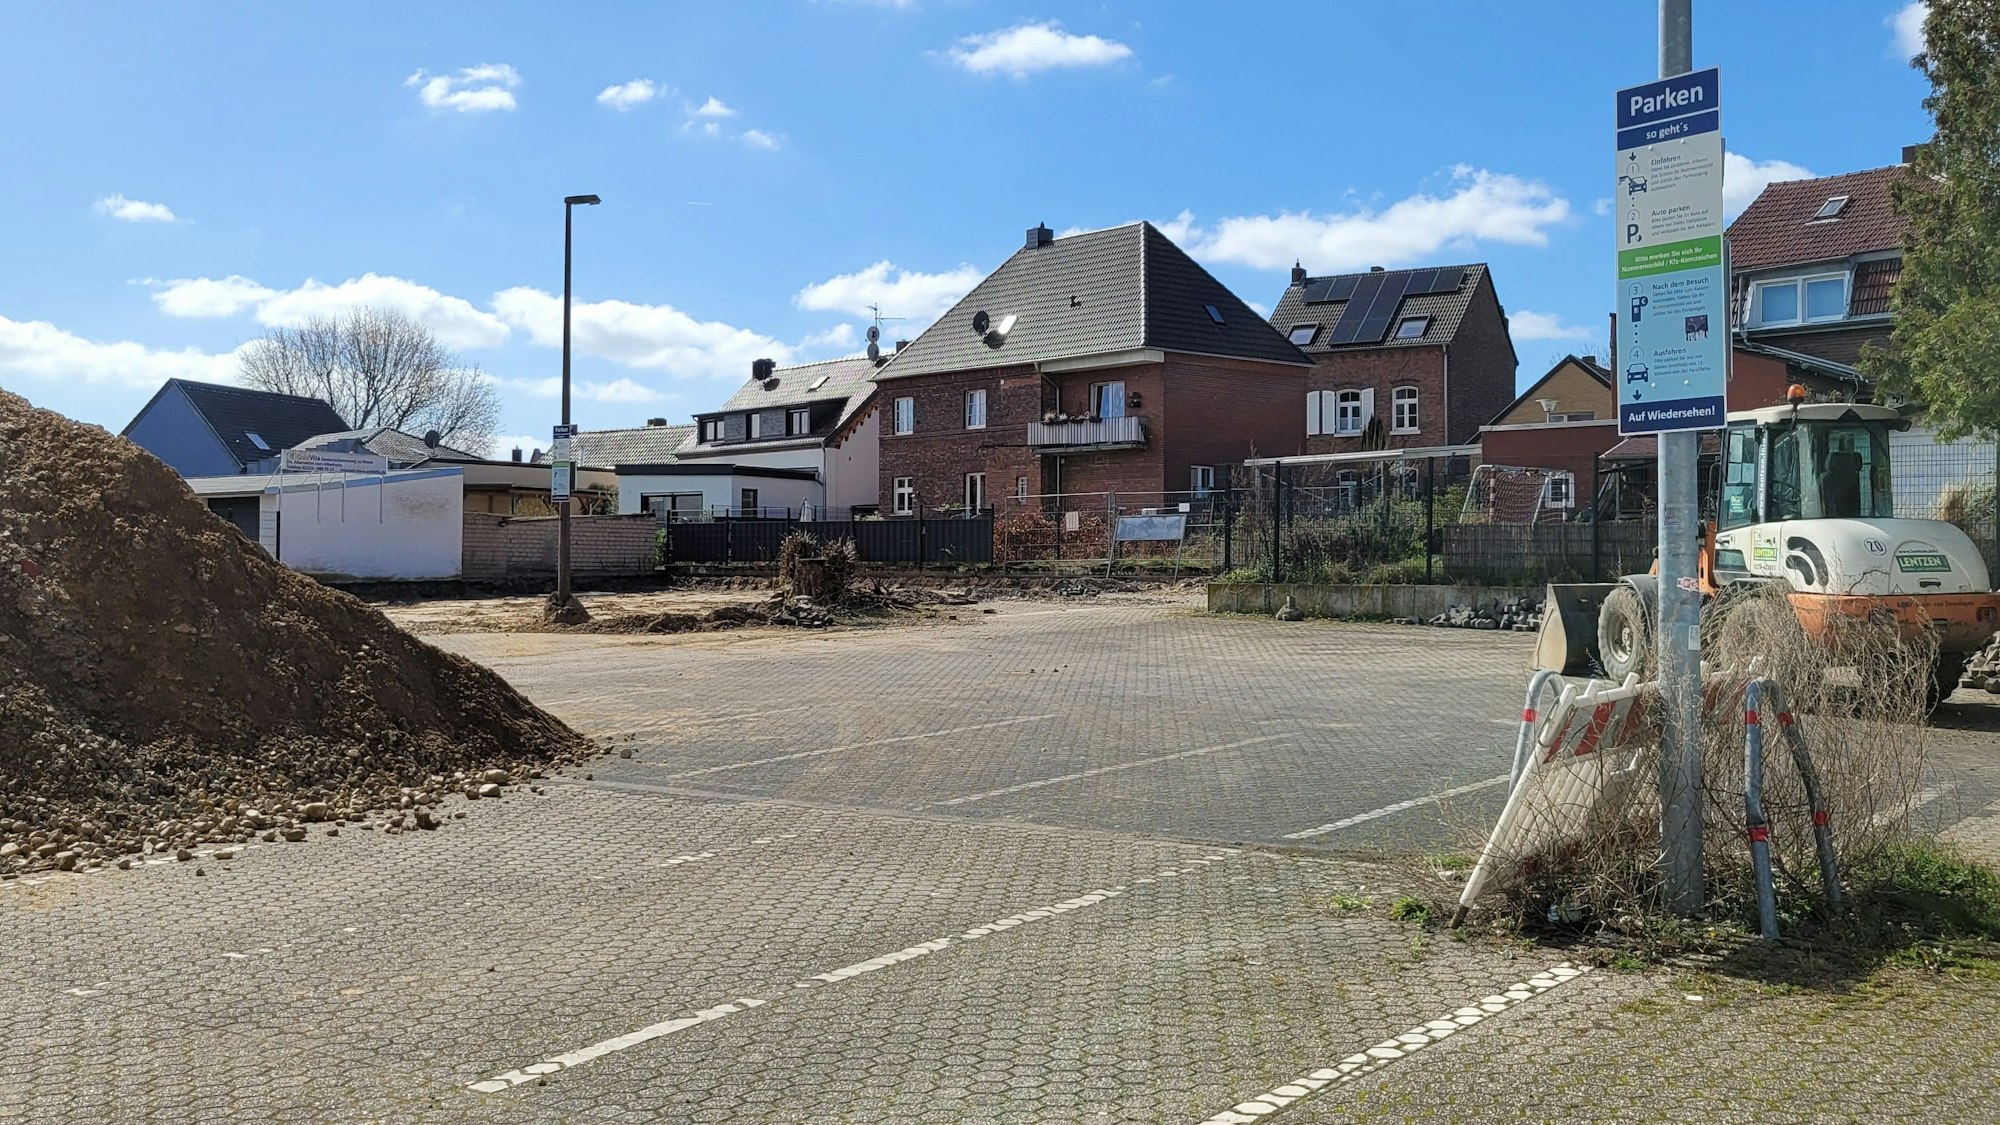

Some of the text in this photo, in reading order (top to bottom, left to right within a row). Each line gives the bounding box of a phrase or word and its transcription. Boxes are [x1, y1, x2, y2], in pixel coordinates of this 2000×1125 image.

[1630, 86, 1703, 117] Parken
[1646, 131, 1657, 139] so
[1651, 155, 1681, 166] Einfahren
[1668, 205, 1691, 215] parken
[1631, 212, 1636, 221] 2
[1649, 253, 1670, 261] merken
[1621, 260, 1665, 273] Nummernschild
[1669, 253, 1718, 265] Kfz-Kennzeichen
[1652, 282, 1669, 291] Nach
[1686, 276, 1709, 286] Besuch
[1633, 286, 1638, 295] 3
[1633, 349, 1639, 359] 4
[1653, 348, 1687, 357] Ausfahren
[1628, 405, 1716, 423] Auf Wiedersehen!
[1866, 541, 1884, 552] 20
[1898, 556, 1943, 567] LENTZEN
